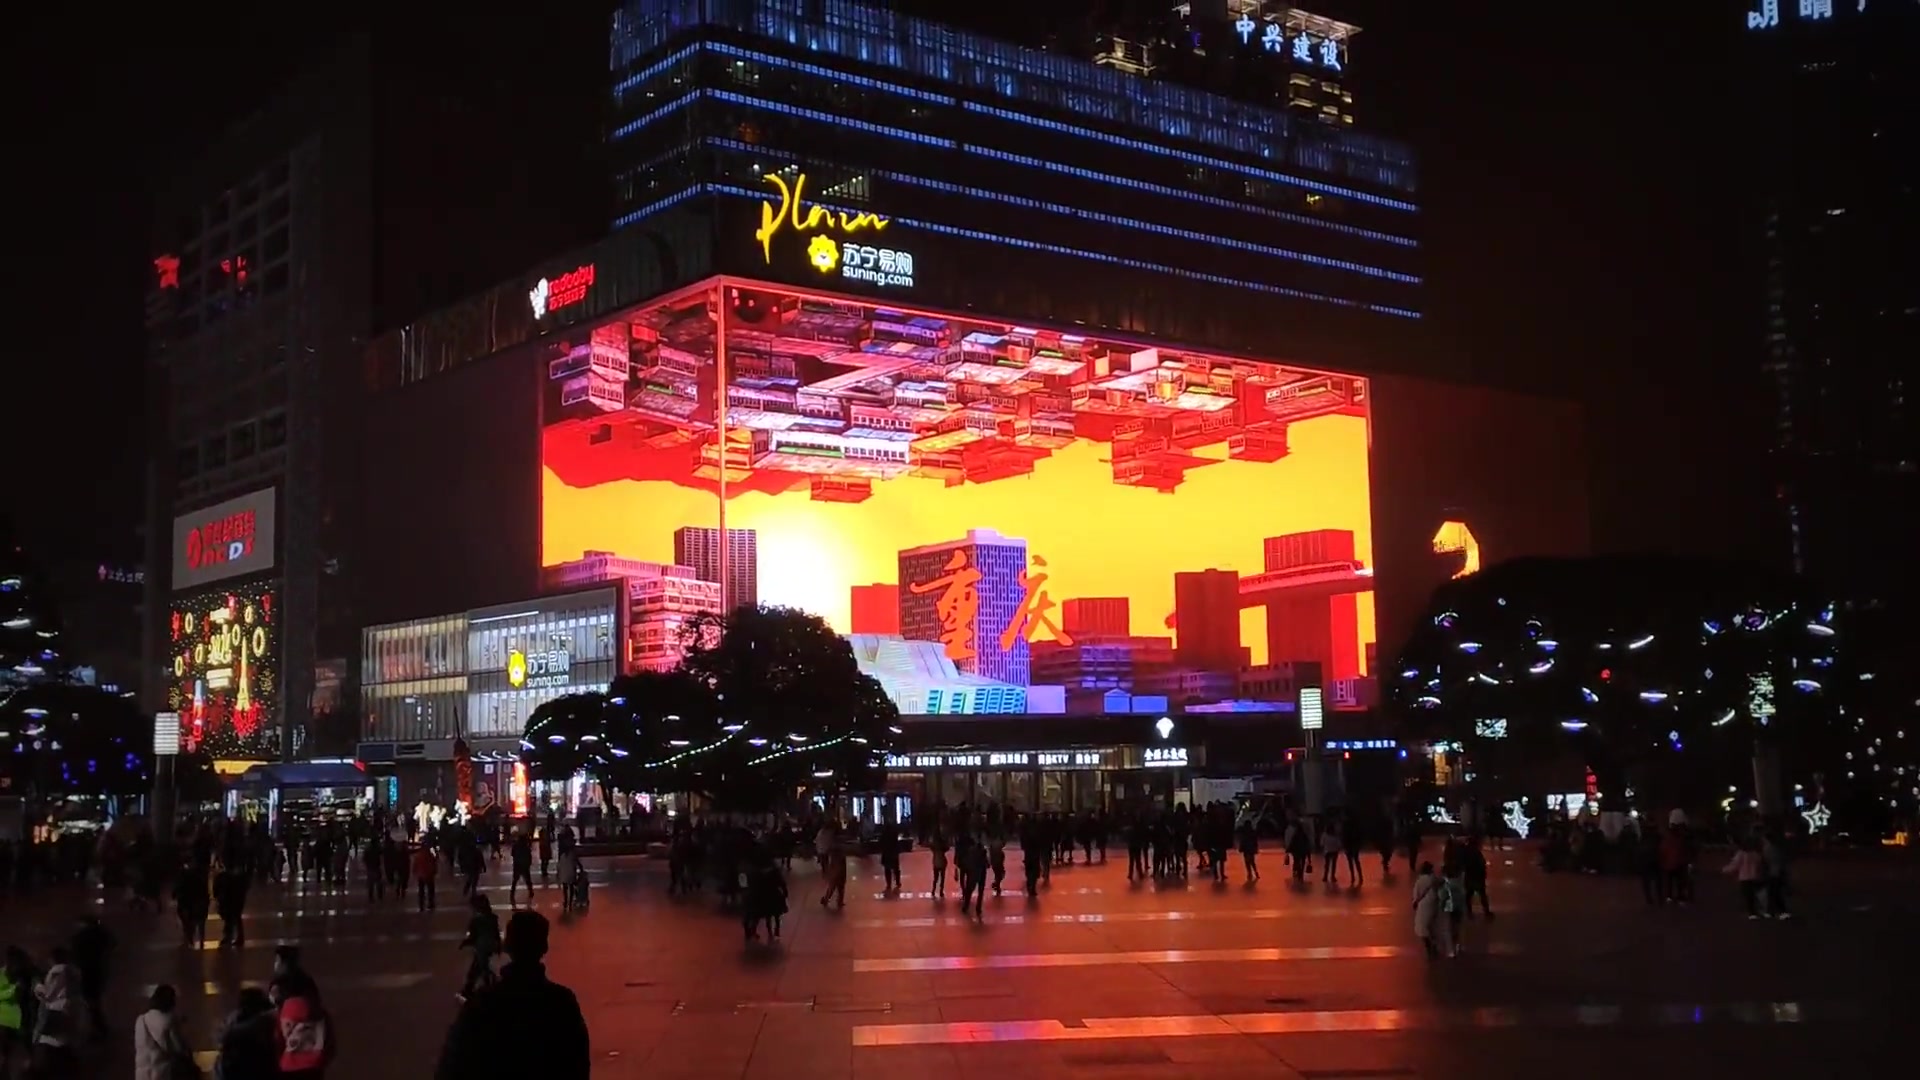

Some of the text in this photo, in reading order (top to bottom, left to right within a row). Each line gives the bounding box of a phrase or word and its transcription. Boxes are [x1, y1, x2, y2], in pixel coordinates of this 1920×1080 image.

[1747, 0, 1867, 29] 朗晴
[1235, 13, 1342, 71] 中兴建设
[842, 242, 914, 276] 苏宁易购
[842, 268, 915, 288] suning.com
[910, 549, 1074, 660] 重庆
[527, 648, 570, 675] 苏宁易购
[526, 675, 570, 688] suning.com
